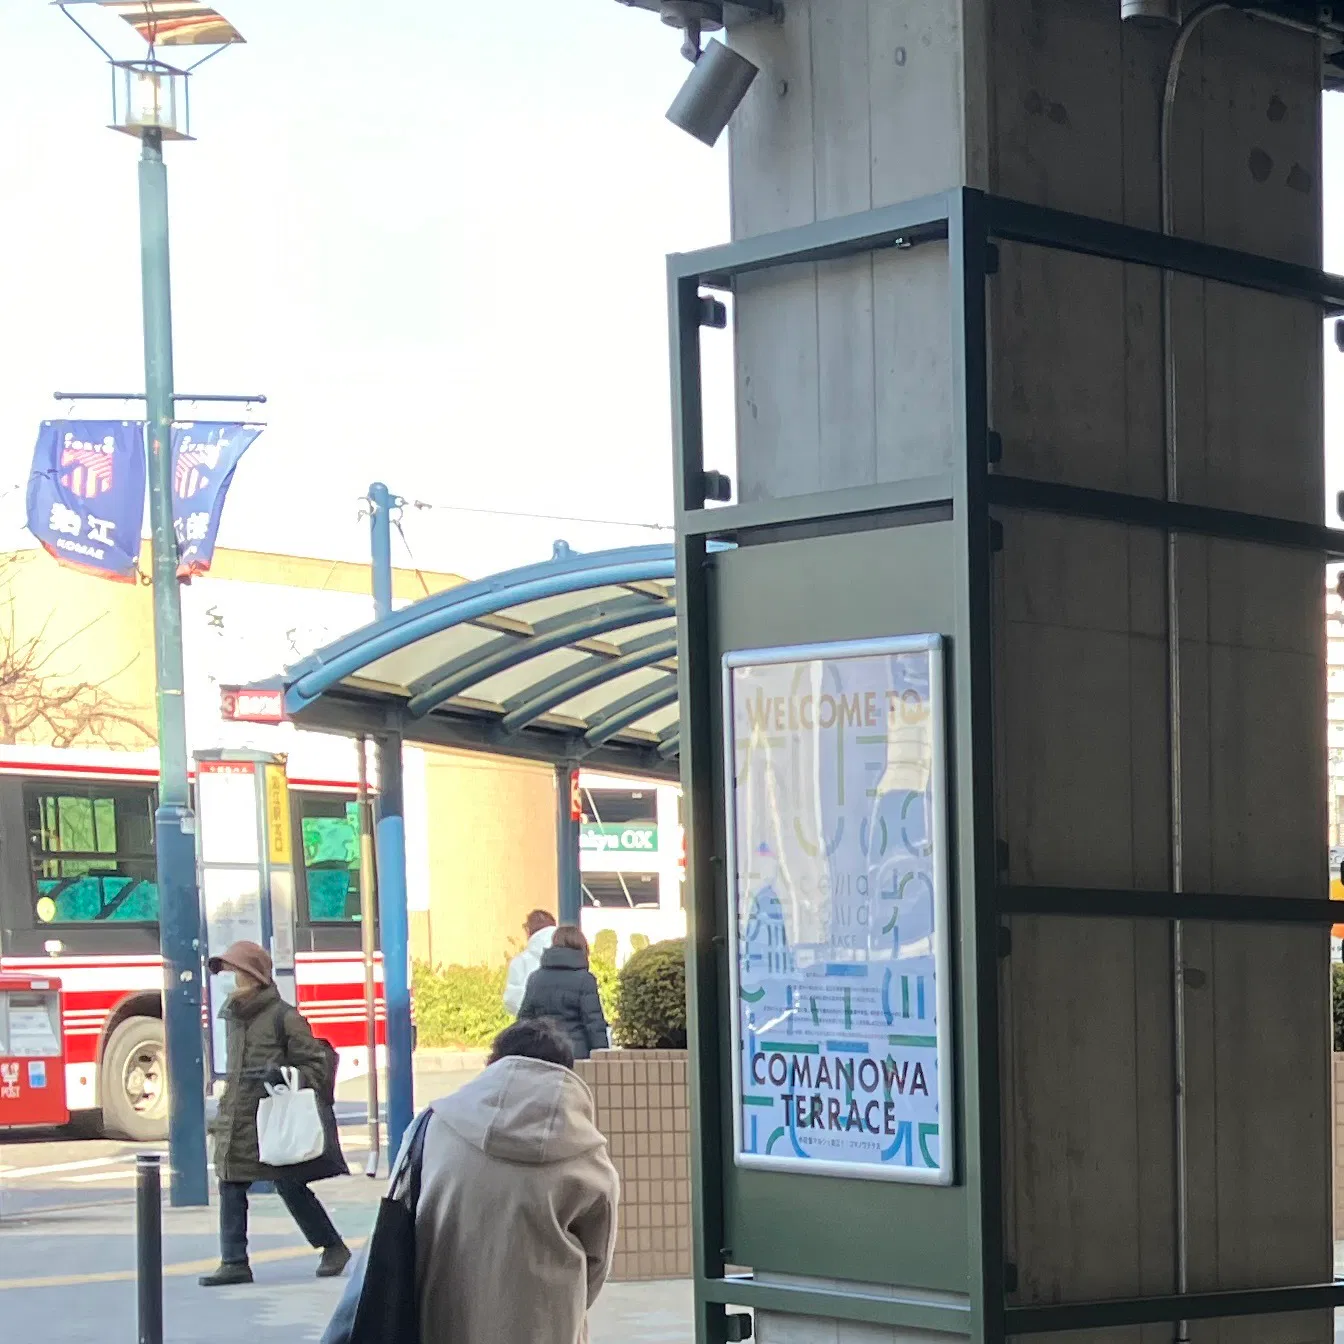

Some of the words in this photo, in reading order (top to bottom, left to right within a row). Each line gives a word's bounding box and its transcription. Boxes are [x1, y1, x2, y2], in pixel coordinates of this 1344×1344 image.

[744, 691, 877, 733] WELCOME
[884, 688, 924, 727] TO
[621, 829, 654, 849] OX
[751, 1051, 929, 1096] COMANOWA
[780, 1093, 897, 1135] TERRACE
